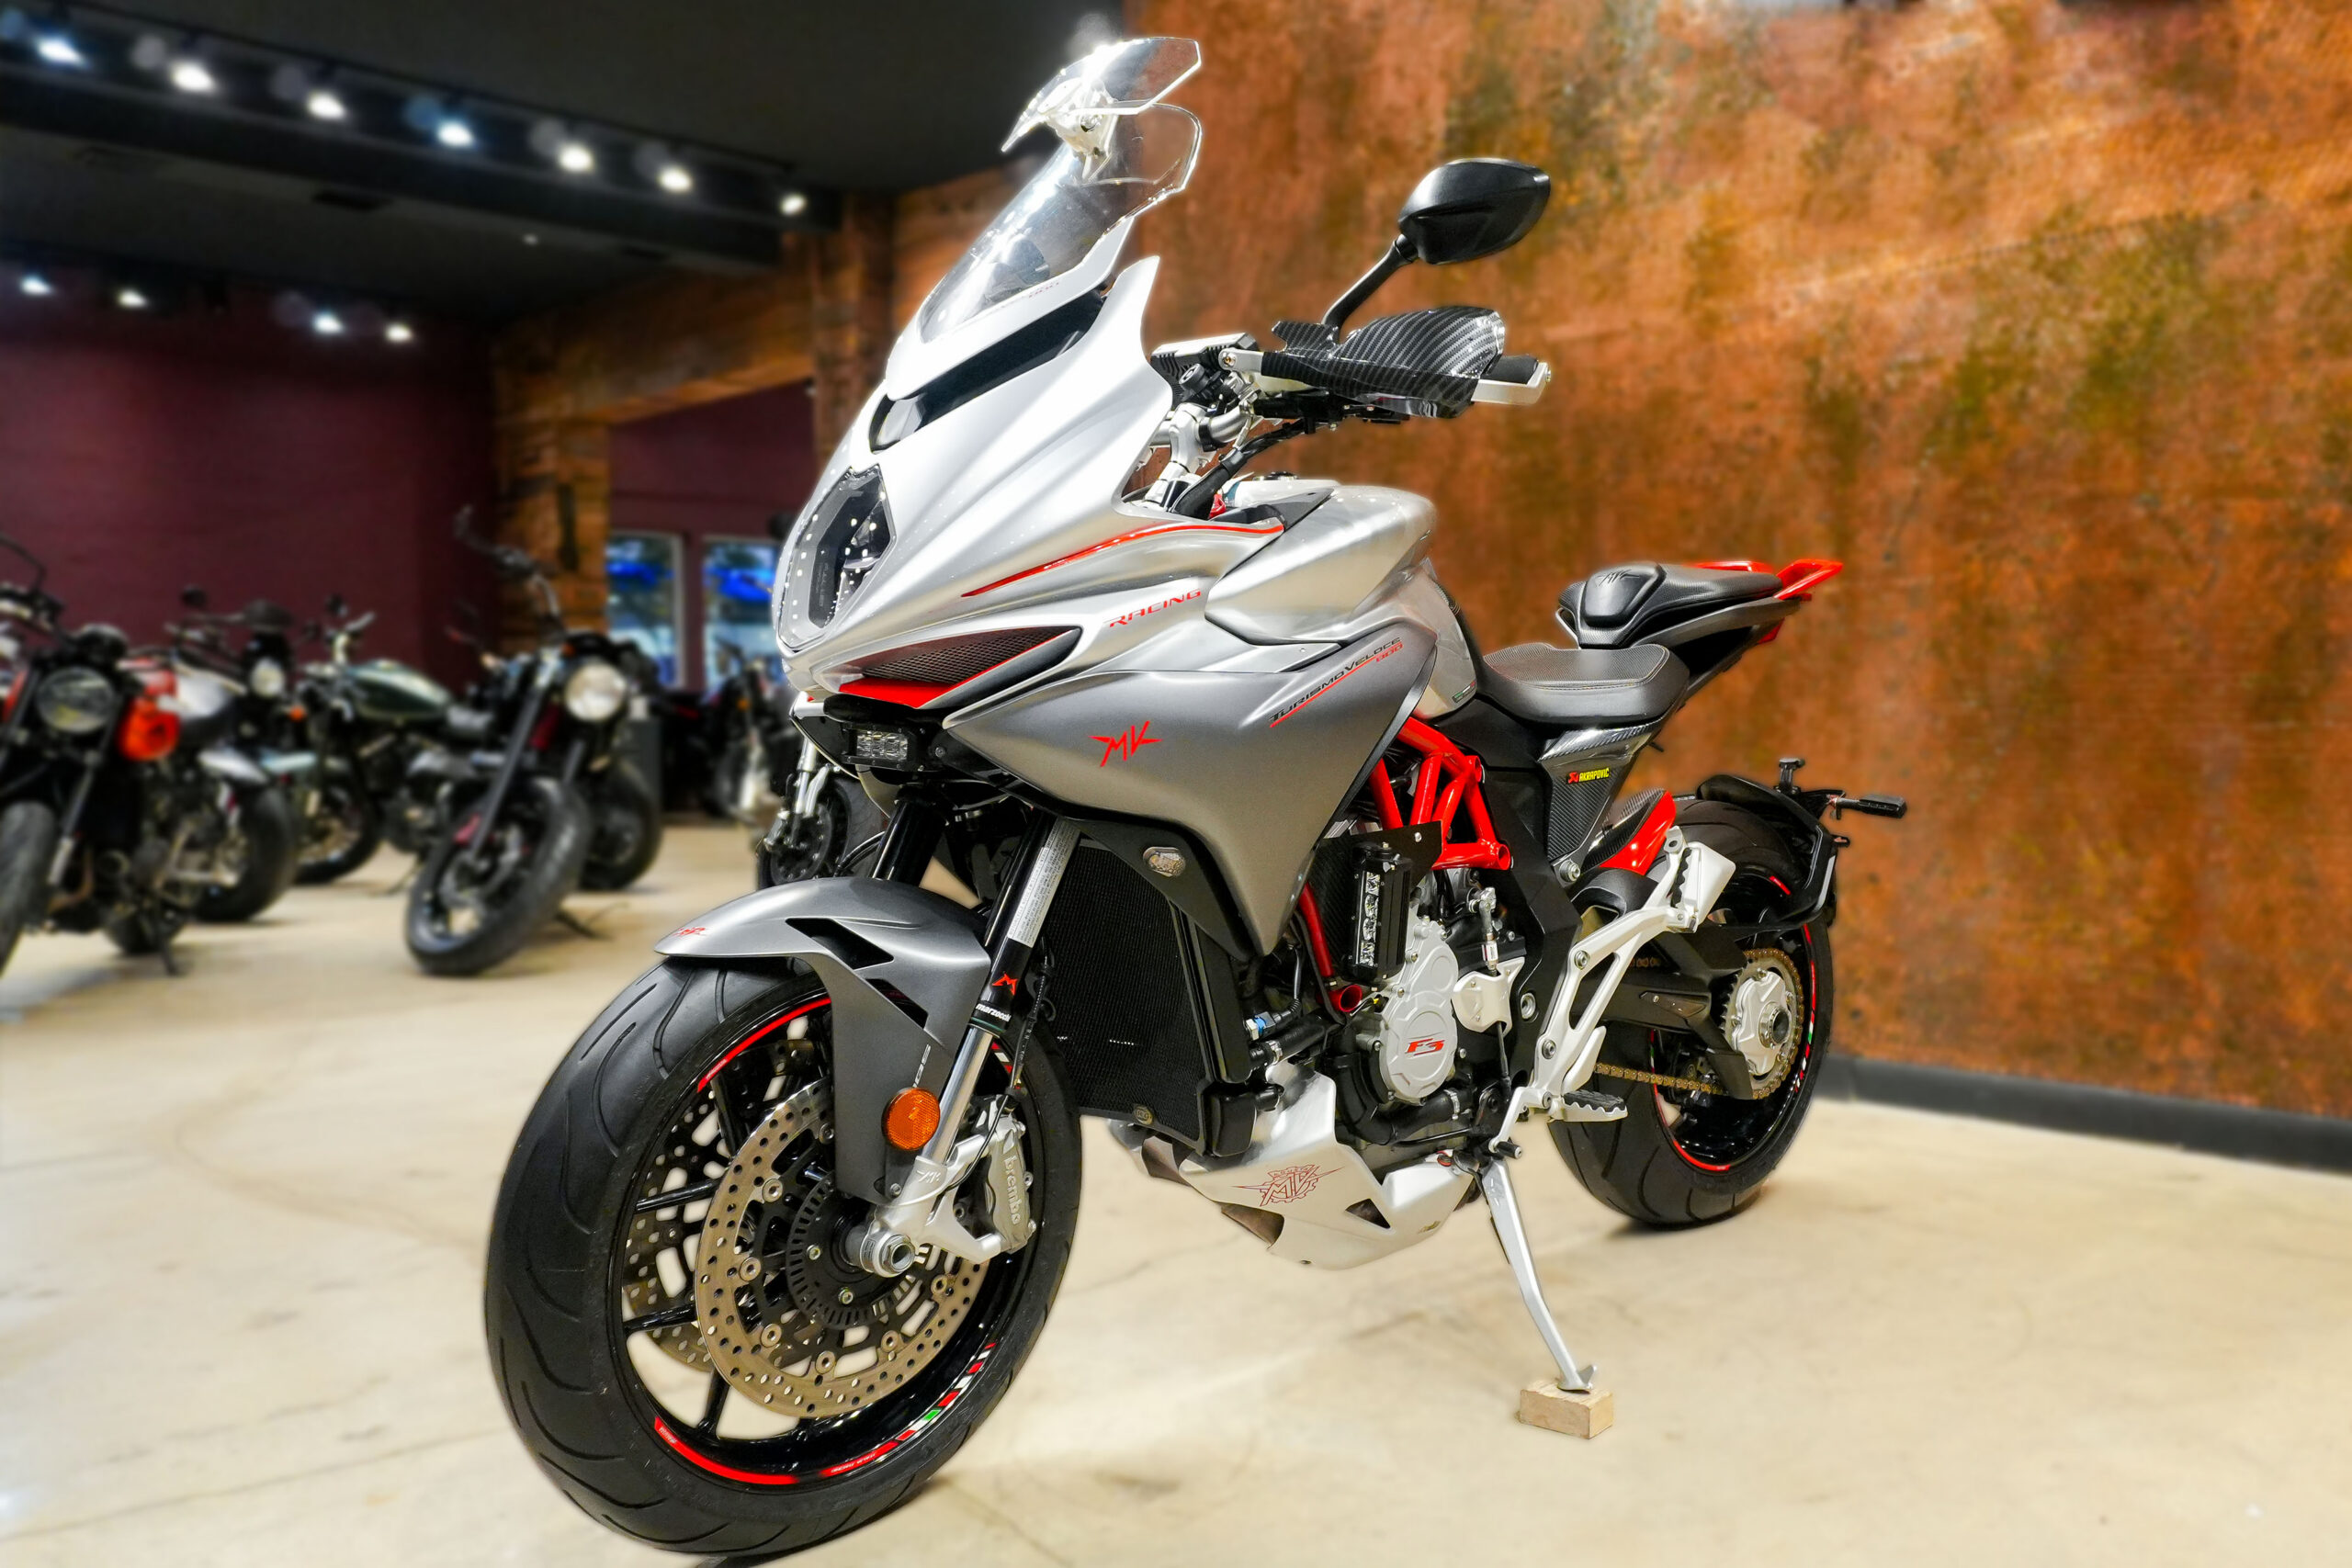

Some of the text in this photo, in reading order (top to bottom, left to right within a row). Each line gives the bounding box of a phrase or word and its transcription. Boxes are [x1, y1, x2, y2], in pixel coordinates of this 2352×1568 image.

[1103, 588, 1203, 627] RACING
[1088, 720, 1163, 768] MV
[975, 1003, 1012, 1022] marzocchi
[1405, 1037, 1446, 1056] F3
[1004, 1155, 1023, 1224] brembo
[1233, 1165, 1341, 1207] MV
